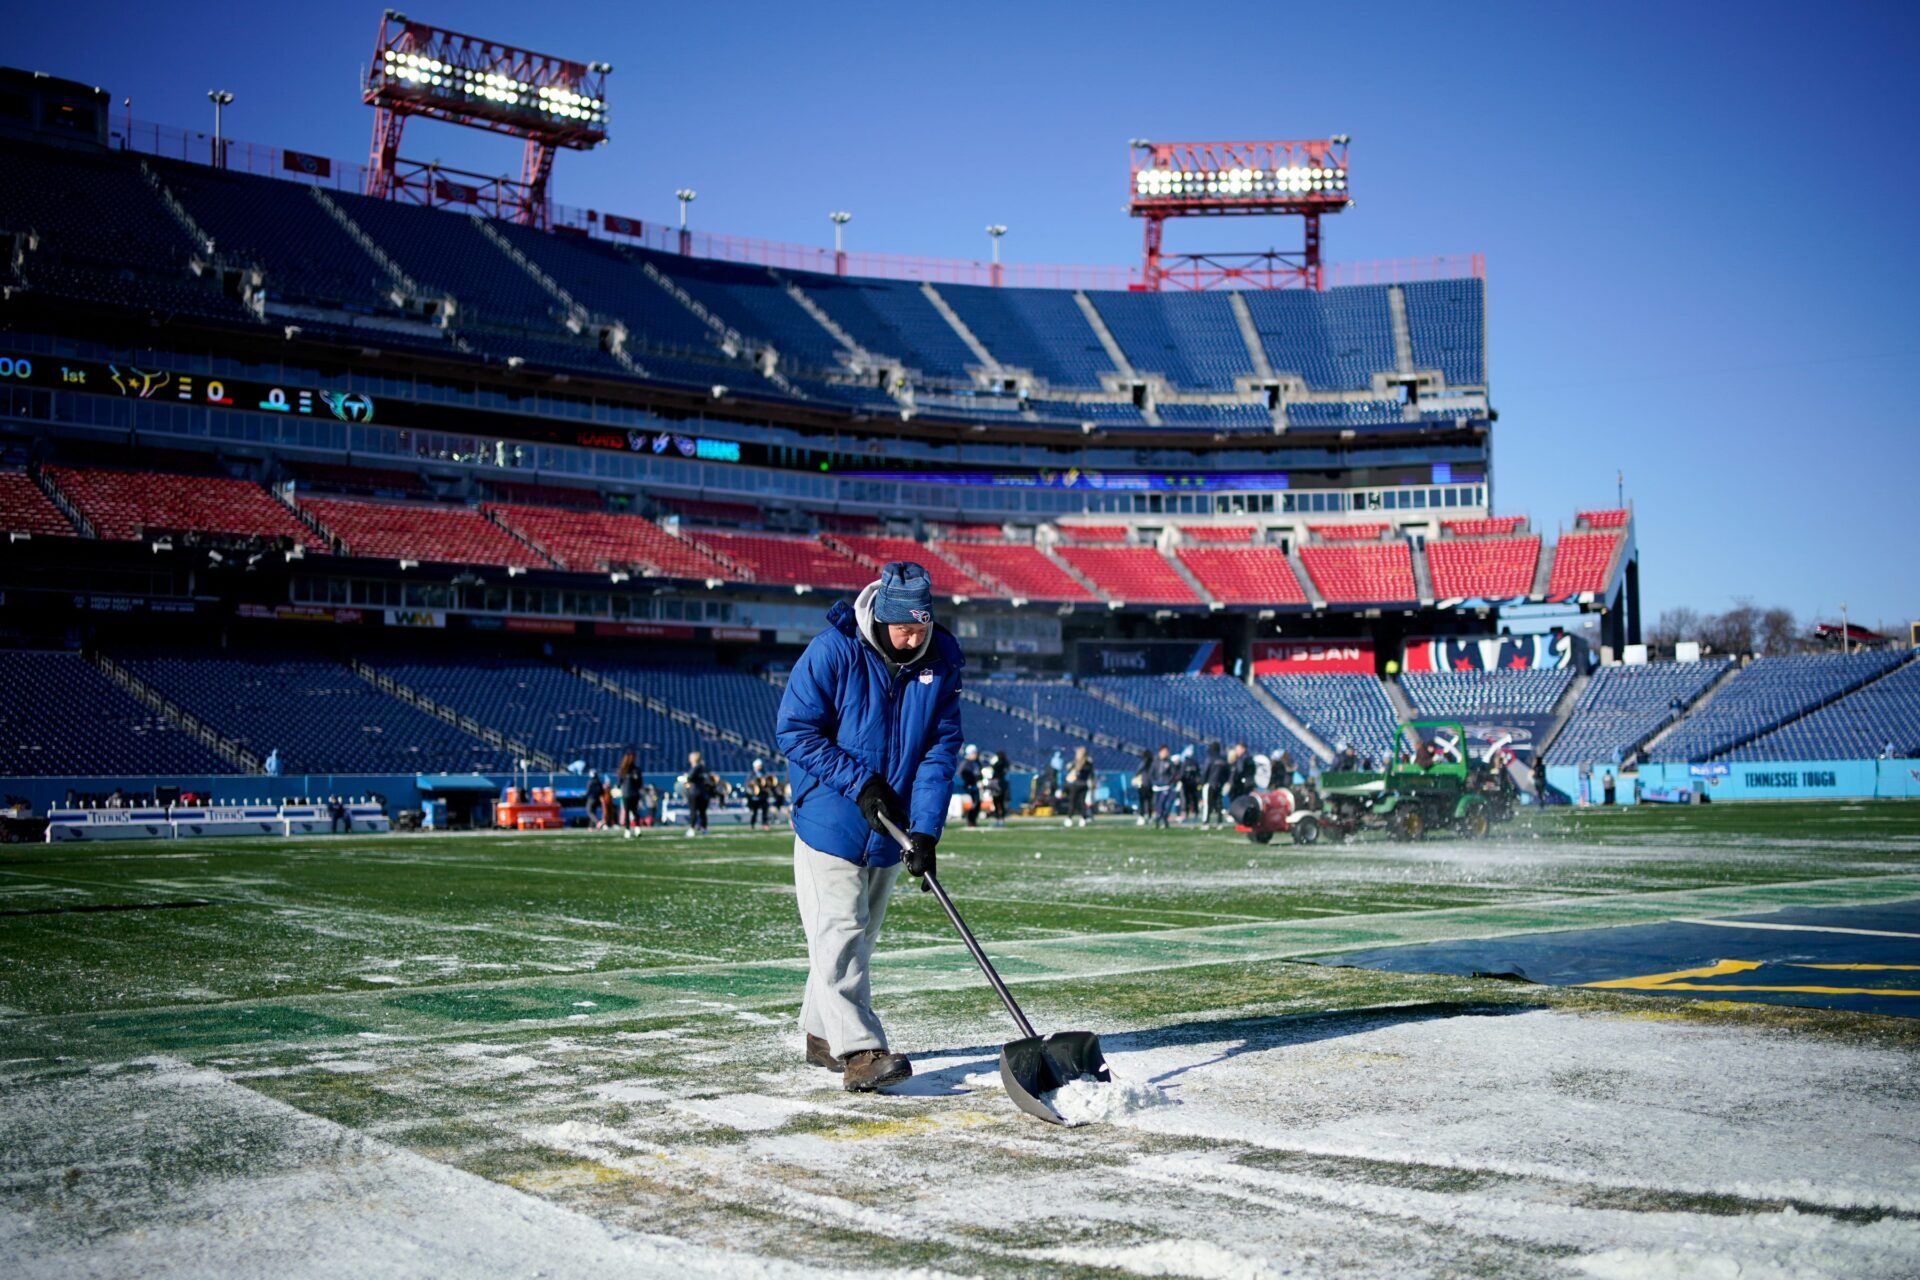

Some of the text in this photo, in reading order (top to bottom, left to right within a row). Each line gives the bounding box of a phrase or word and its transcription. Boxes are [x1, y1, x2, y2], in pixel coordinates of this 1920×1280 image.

[60, 366, 88, 385] 1st
[207, 381, 224, 400] 0
[268, 388, 286, 408] 0
[395, 611, 434, 626] WM
[1267, 646, 1361, 662] NISSAN
[1745, 771, 1836, 788] TENNESSEE TOUGH
[86, 811, 131, 824] TITANS
[204, 809, 246, 822] TITANS
